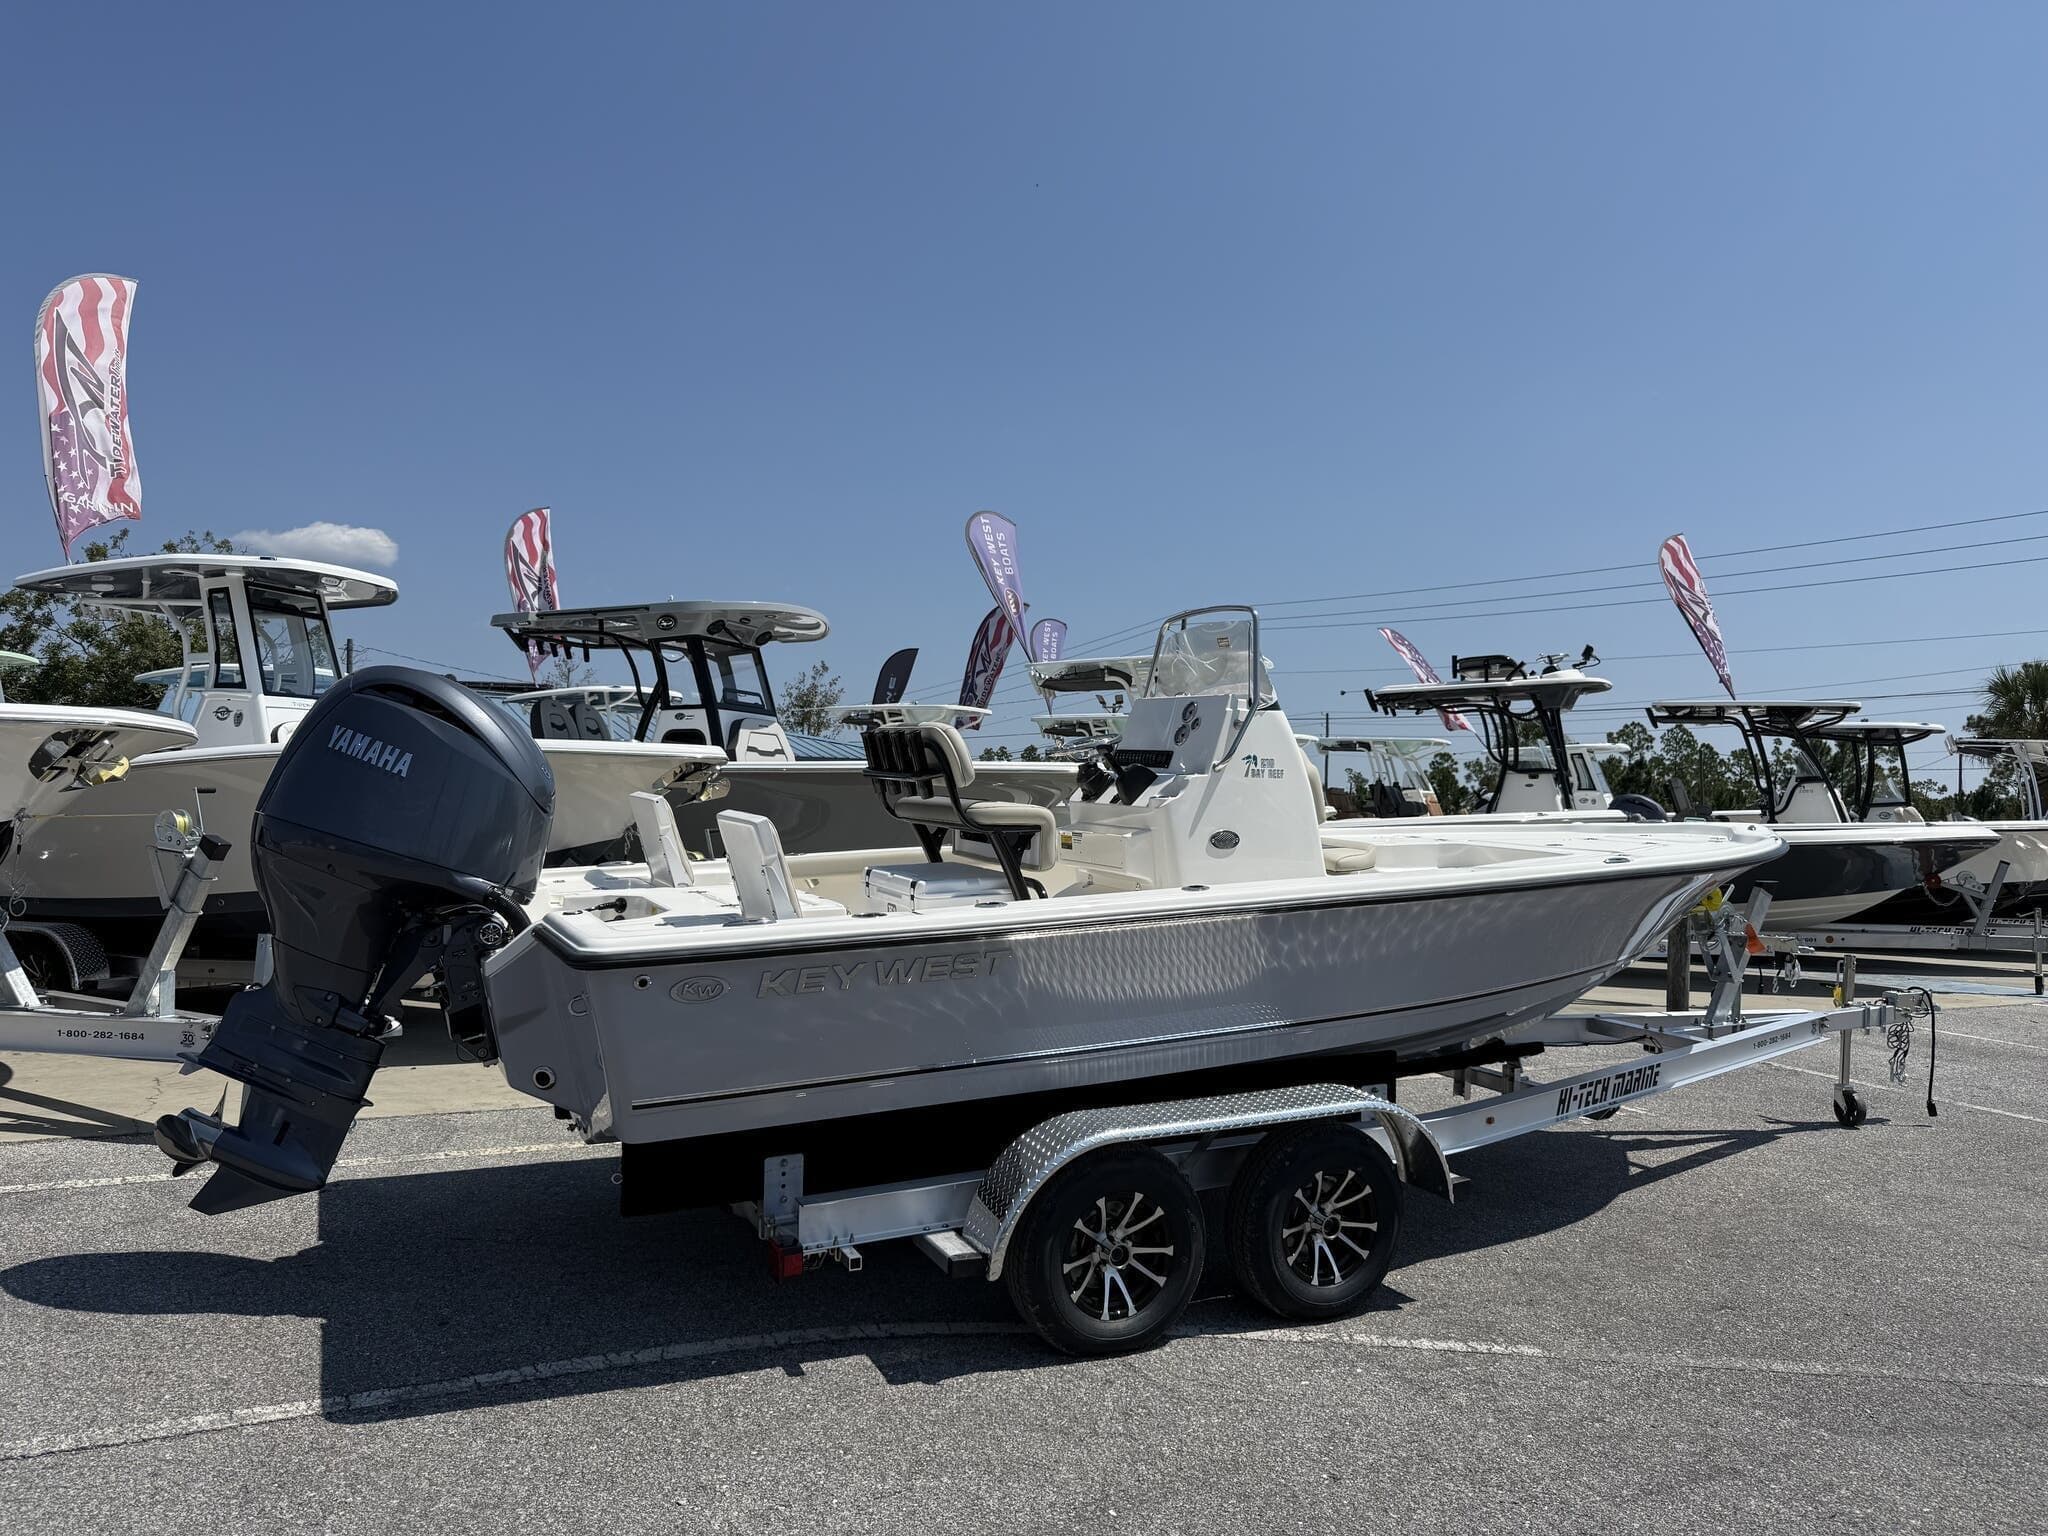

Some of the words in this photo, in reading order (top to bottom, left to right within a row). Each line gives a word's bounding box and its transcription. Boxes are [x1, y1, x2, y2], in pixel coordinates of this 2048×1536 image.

[109, 374, 126, 479] TIDEWATER
[980, 516, 997, 555] WEST
[996, 532, 1014, 575] BOATS
[991, 558, 1005, 586] KEY
[1044, 621, 1052, 645] WEST
[1050, 631, 1059, 659] BOATS
[328, 724, 414, 778] YAMAHA
[1250, 768, 1266, 778] BAY
[1267, 769, 1285, 779] REEF
[755, 961, 868, 999] KEY
[873, 951, 1012, 987] WEST
[57, 1029, 145, 1041] 1-800-282-1684
[182, 1033, 194, 1043] 30
[1556, 1076, 1611, 1116] HI-TECH
[1611, 1062, 1662, 1099] MARINE
